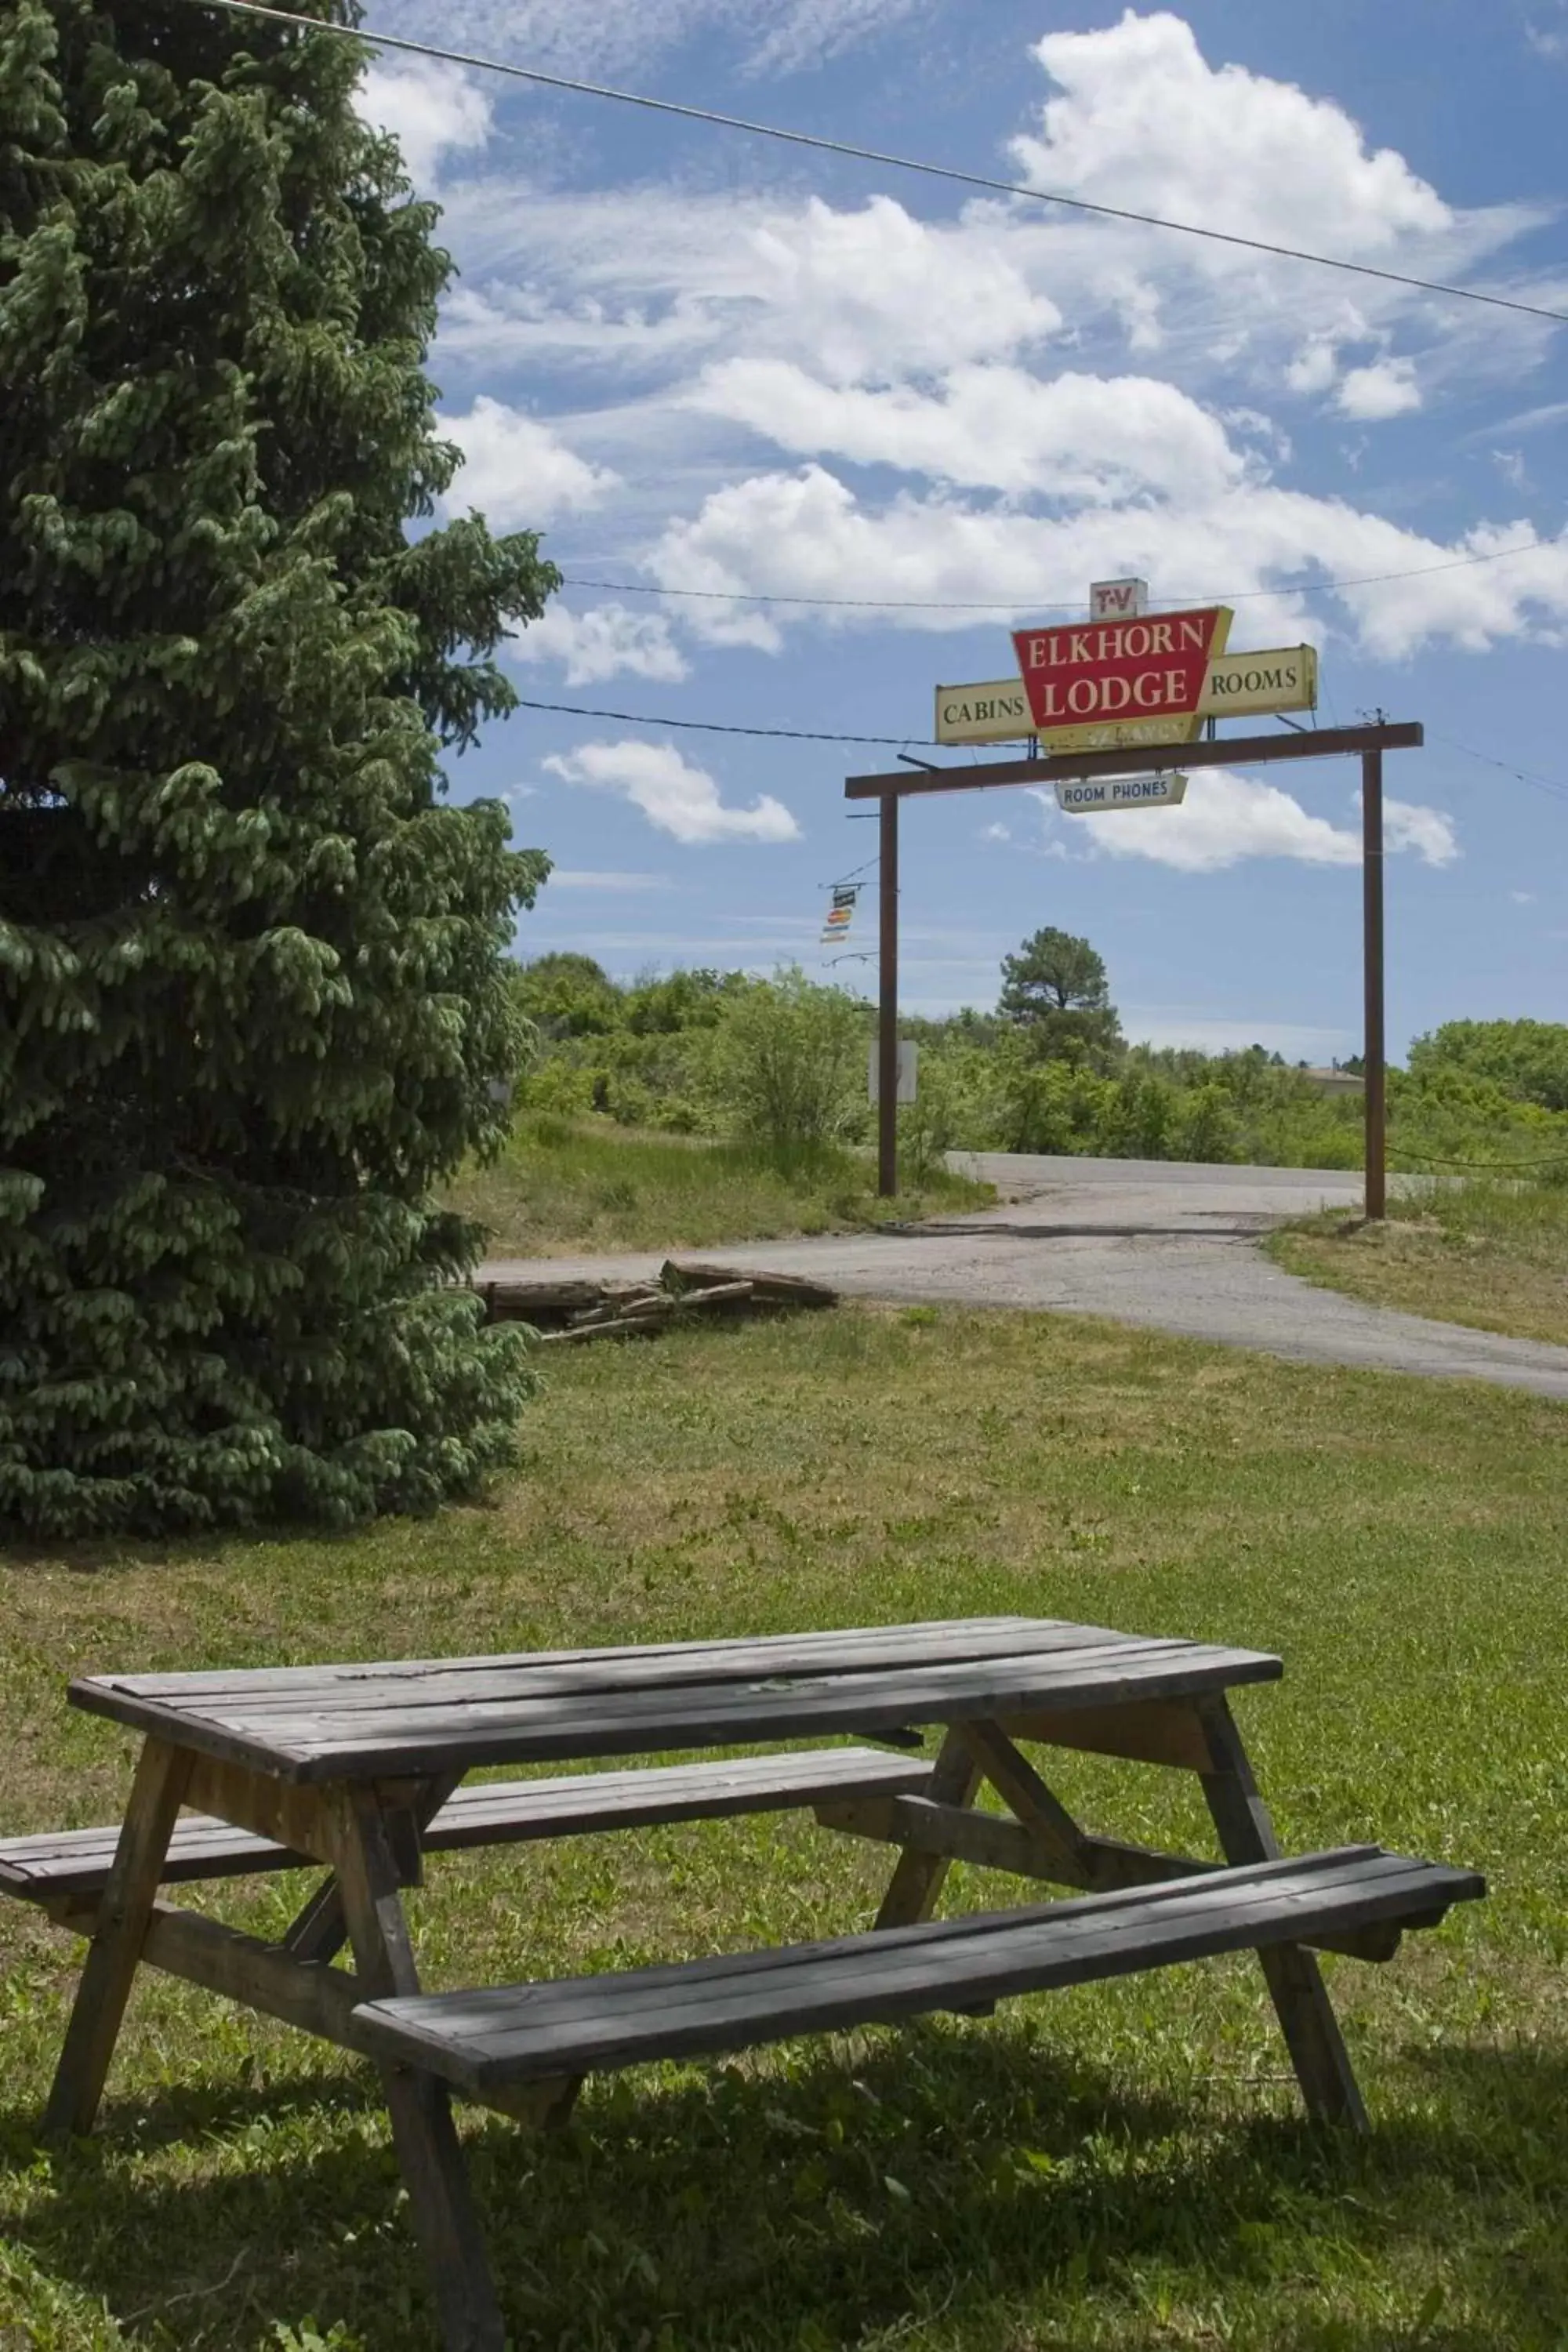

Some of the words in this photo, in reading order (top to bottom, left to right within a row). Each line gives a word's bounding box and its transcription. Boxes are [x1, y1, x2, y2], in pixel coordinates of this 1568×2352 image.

[1028, 619, 1205, 669] ELKHORN
[1044, 670, 1187, 717] LODGE
[1211, 667, 1298, 695] ROOMS
[943, 697, 1025, 724] CABINS
[1064, 787, 1105, 804] ROOM
[1112, 781, 1167, 800] PHONES
